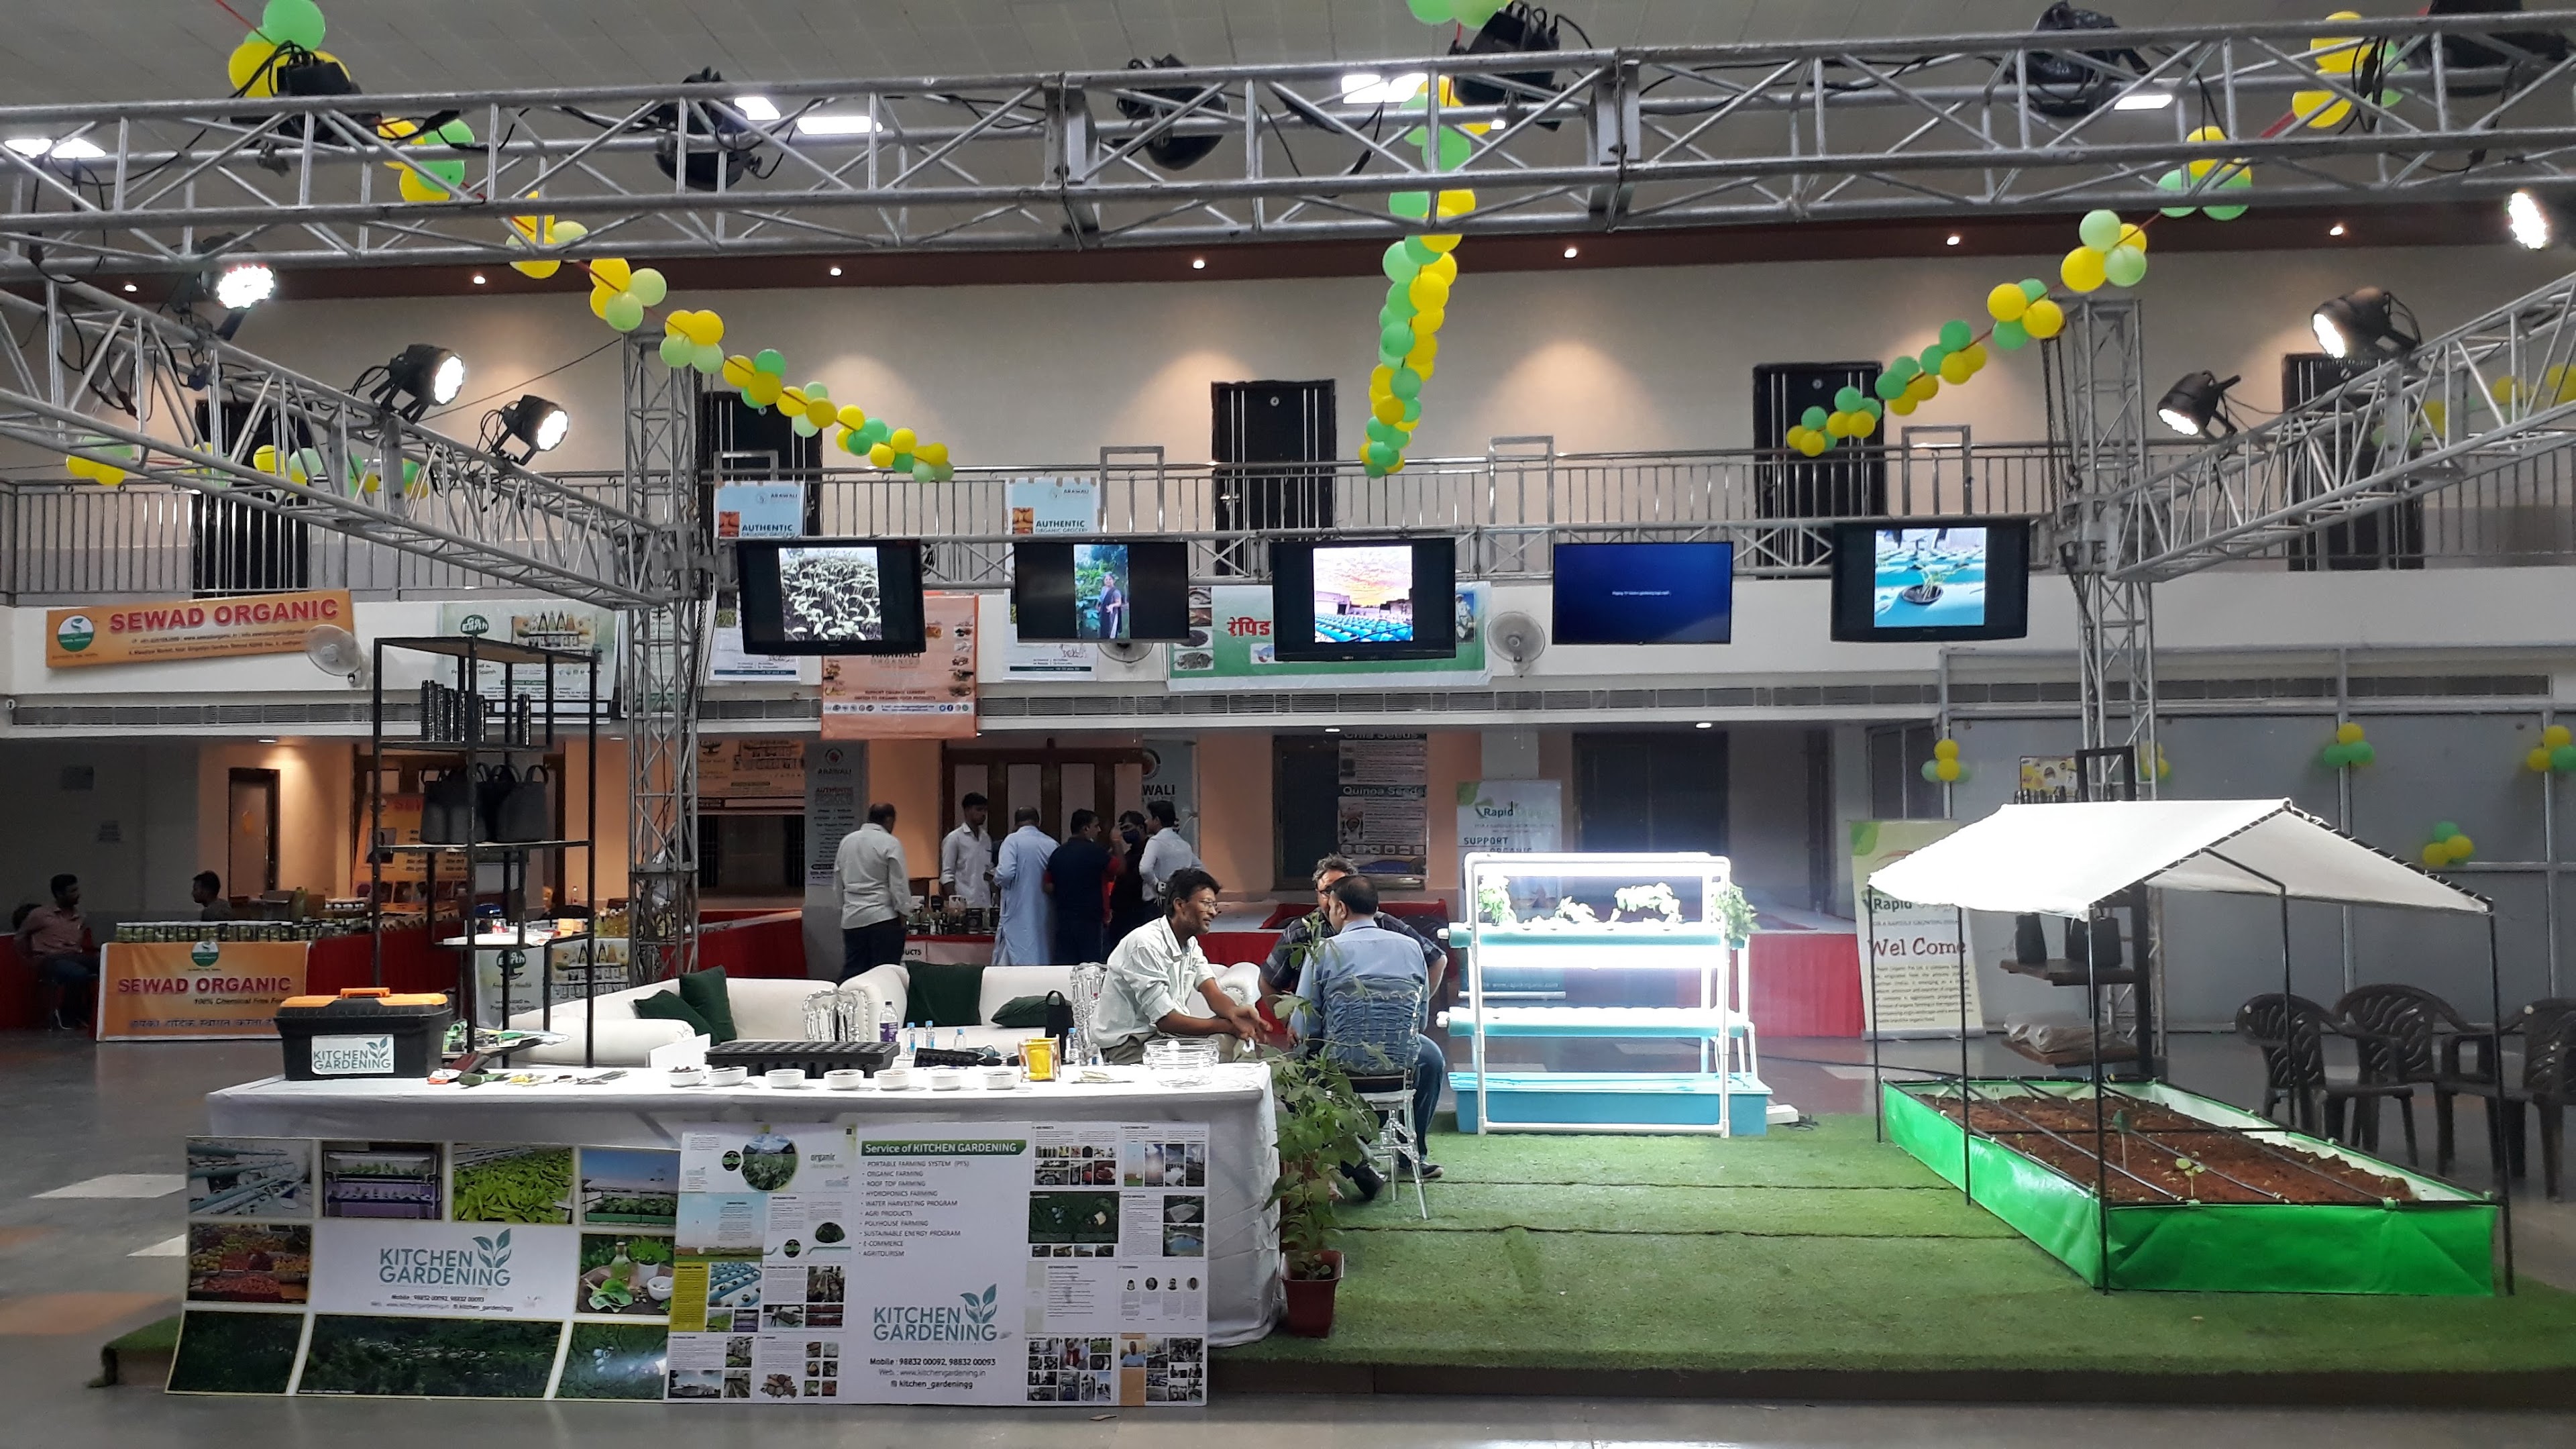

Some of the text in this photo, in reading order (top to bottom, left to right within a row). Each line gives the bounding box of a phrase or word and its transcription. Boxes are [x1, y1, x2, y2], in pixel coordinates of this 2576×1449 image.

[741, 524, 793, 532] AUTHENTIC
[109, 598, 338, 633] SEWAD ORGANIC
[1227, 616, 1272, 637] रेपिड
[1142, 784, 1175, 796] WALI
[1343, 786, 1384, 795] Quinoa
[1484, 800, 1514, 818] Rapid
[1463, 837, 1509, 845] SUPPORT
[1868, 938, 1907, 956] Wel
[498, 955, 526, 965] Erth
[118, 977, 292, 994] SEWAD ORGANIC
[313, 1050, 368, 1060] KITCHEN
[313, 1059, 391, 1070] GARDENING
[865, 1142, 1017, 1153] Service of KITCHEN GARDENING
[380, 1248, 473, 1267] KITCHEN
[380, 1265, 511, 1287] GARDENING
[873, 1306, 961, 1324] KITCHEN
[873, 1324, 998, 1341] GARDENING
